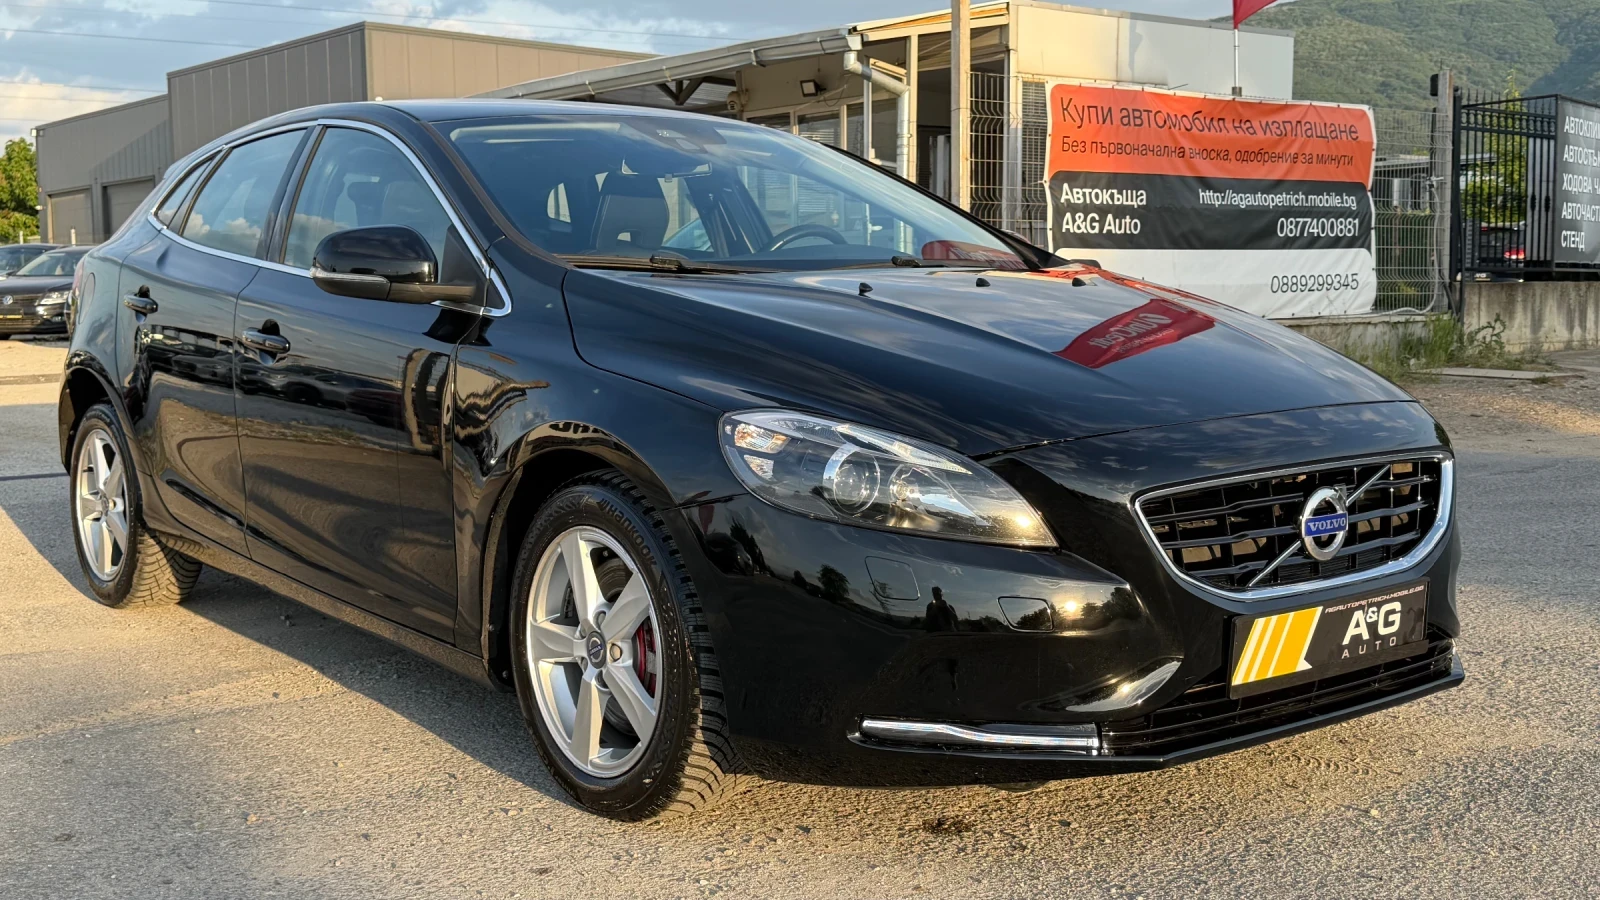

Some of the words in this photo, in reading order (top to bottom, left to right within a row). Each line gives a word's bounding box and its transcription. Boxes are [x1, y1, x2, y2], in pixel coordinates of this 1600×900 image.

[1060, 97, 1114, 130] Купи
[1119, 107, 1230, 135] автомобил
[1232, 118, 1258, 136] на
[1258, 120, 1359, 143] изплащане
[1061, 135, 1087, 153] Без
[1090, 141, 1186, 158] първоначална
[1188, 147, 1232, 164] вноска,
[1234, 148, 1299, 166] одобрение
[1300, 152, 1314, 165] за
[1315, 153, 1354, 169] минути
[1060, 182, 1147, 206] Автокъща
[1562, 172, 1593, 195] ХОДОВА
[1594, 177, 1600, 195] Ч
[1199, 188, 1357, 210] http://agautopetrich.mobile.bg
[1561, 201, 1600, 222] АВТОЧАСТ
[1061, 212, 1100, 234] A&G
[1102, 213, 1141, 235] Auto
[1276, 217, 1359, 237] 0877400881
[1561, 229, 1585, 252] СТЕНД
[1270, 273, 1359, 294] 0889299345
[1308, 518, 1347, 532] VOLVO
[1342, 601, 1401, 645] A&G
[1341, 636, 1397, 660] AUTO
